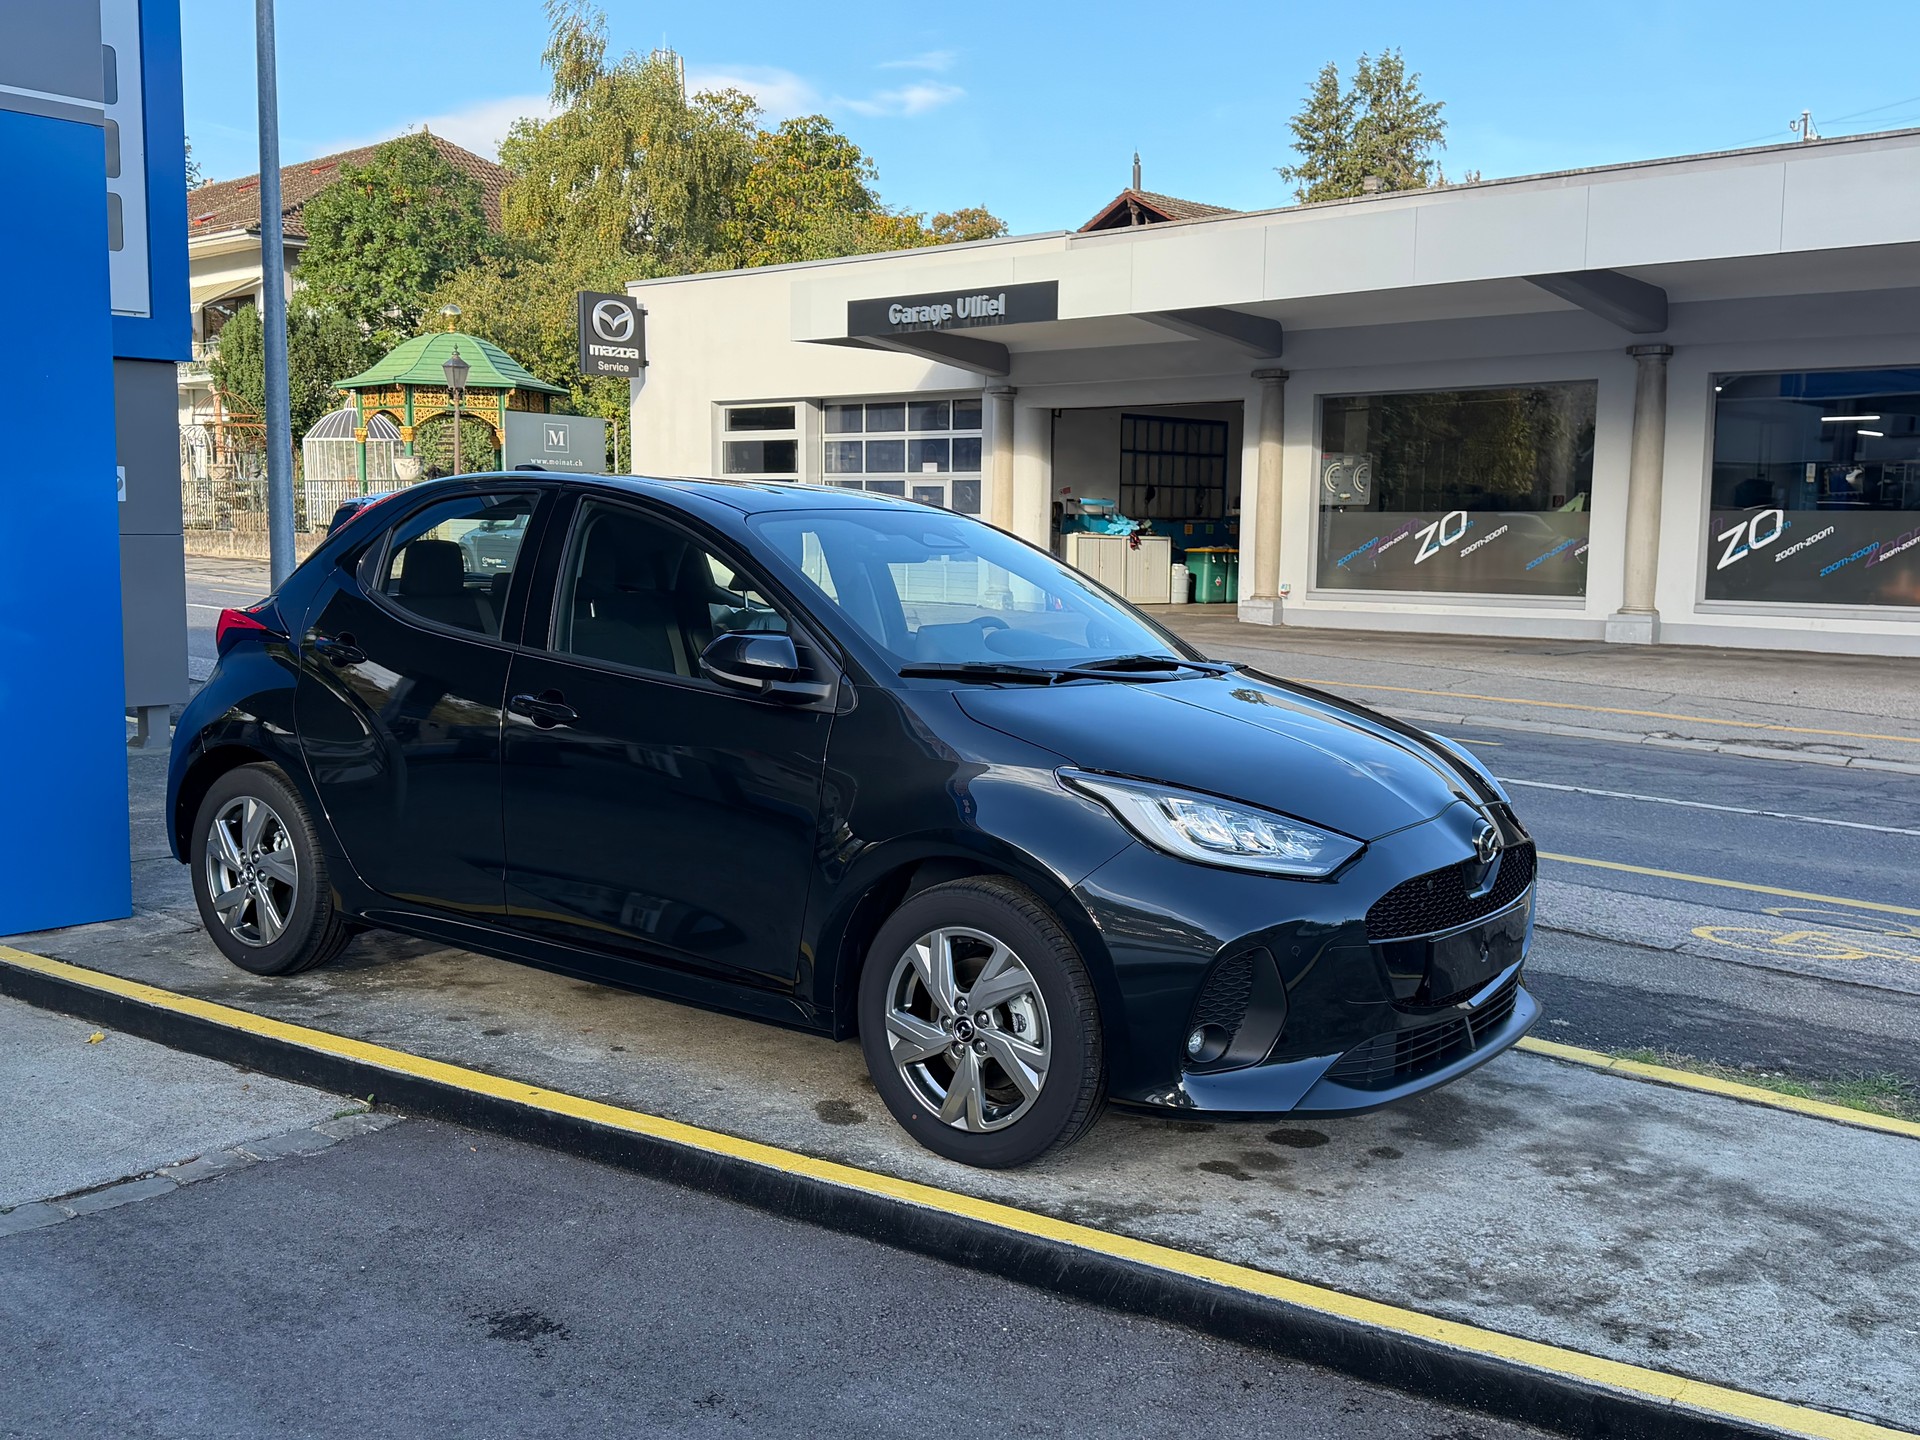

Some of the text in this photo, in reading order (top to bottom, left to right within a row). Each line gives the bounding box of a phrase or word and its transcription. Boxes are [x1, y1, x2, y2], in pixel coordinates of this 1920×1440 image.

[888, 293, 1006, 325] Garage Ulliel
[590, 344, 639, 359] mazda
[598, 360, 629, 372] Service
[548, 430, 565, 446] M
[530, 457, 583, 467] www.moinat.ch
[1378, 531, 1409, 553] zoom-zoom
[1460, 525, 1508, 557] zoom-zoom
[1775, 525, 1834, 562] zoom-zoom
[1819, 541, 1881, 577] zoom-zoom
